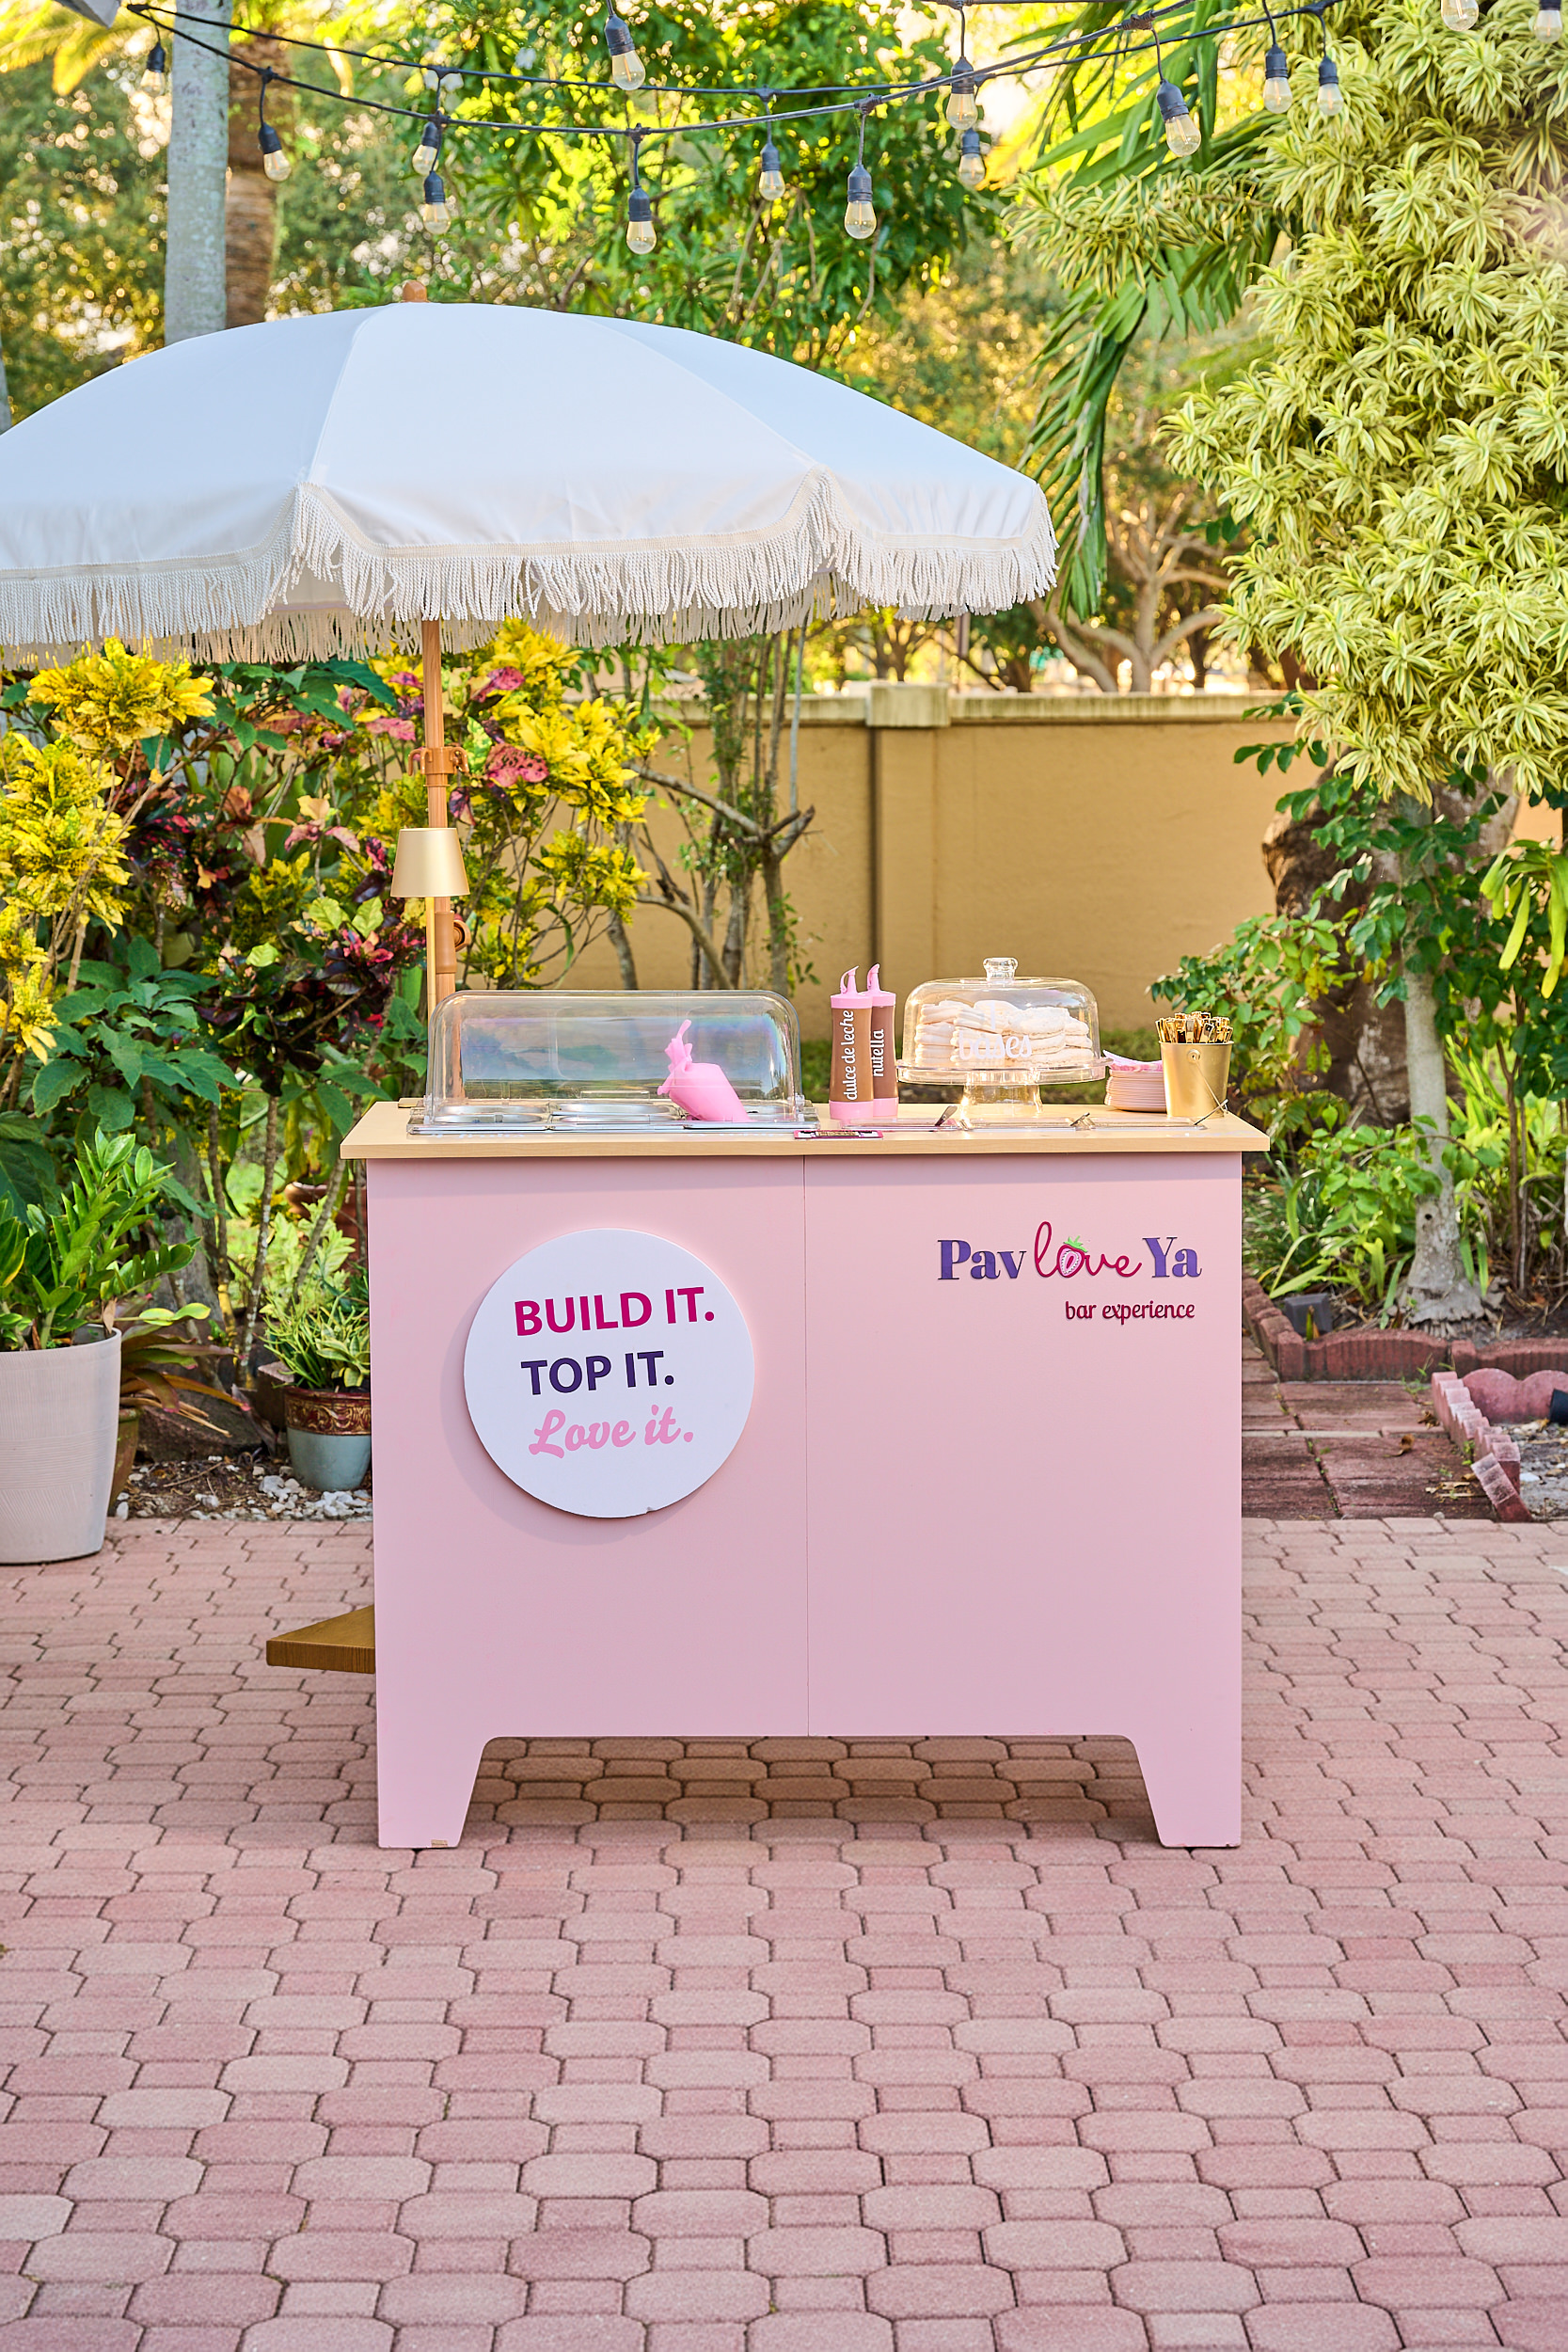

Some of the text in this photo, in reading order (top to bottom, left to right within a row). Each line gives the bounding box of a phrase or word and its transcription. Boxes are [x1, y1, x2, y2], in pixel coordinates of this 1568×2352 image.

[839, 1009, 858, 1101] dulce de leche
[870, 1028, 885, 1077] nutella
[958, 1030, 1033, 1060] bases
[514, 1286, 715, 1336] BUILD IT.
[1065, 1300, 1196, 1326] bar experience
[520, 1350, 674, 1395] TOP IT.
[528, 1404, 694, 1459] Love it.
